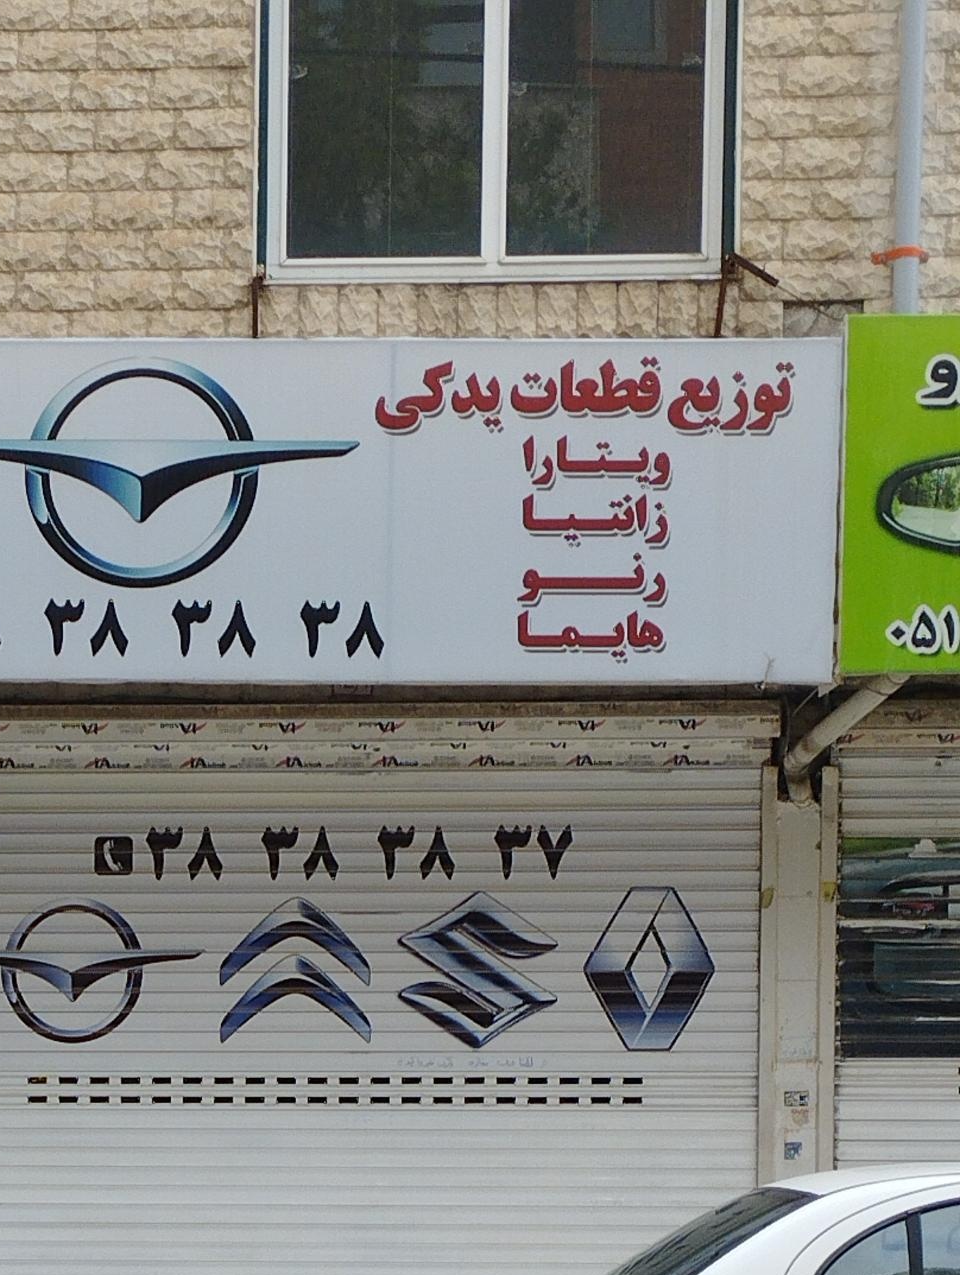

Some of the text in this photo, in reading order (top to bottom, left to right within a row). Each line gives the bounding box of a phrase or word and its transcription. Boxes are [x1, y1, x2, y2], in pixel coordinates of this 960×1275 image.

[375, 356, 795, 430] توزیع قطعات یدکی
[522, 435, 672, 486] ویتارا
[522, 494, 670, 543] زانتیا
[517, 553, 667, 602] رنو
[44, 600, 128, 659] ۳۸
[172, 600, 256, 659] ۳۸
[300, 600, 385, 659] ۳۸
[517, 611, 665, 659] هایما
[146, 824, 574, 881] ۳۸ ۳۸ ۳۸ ۳۷
